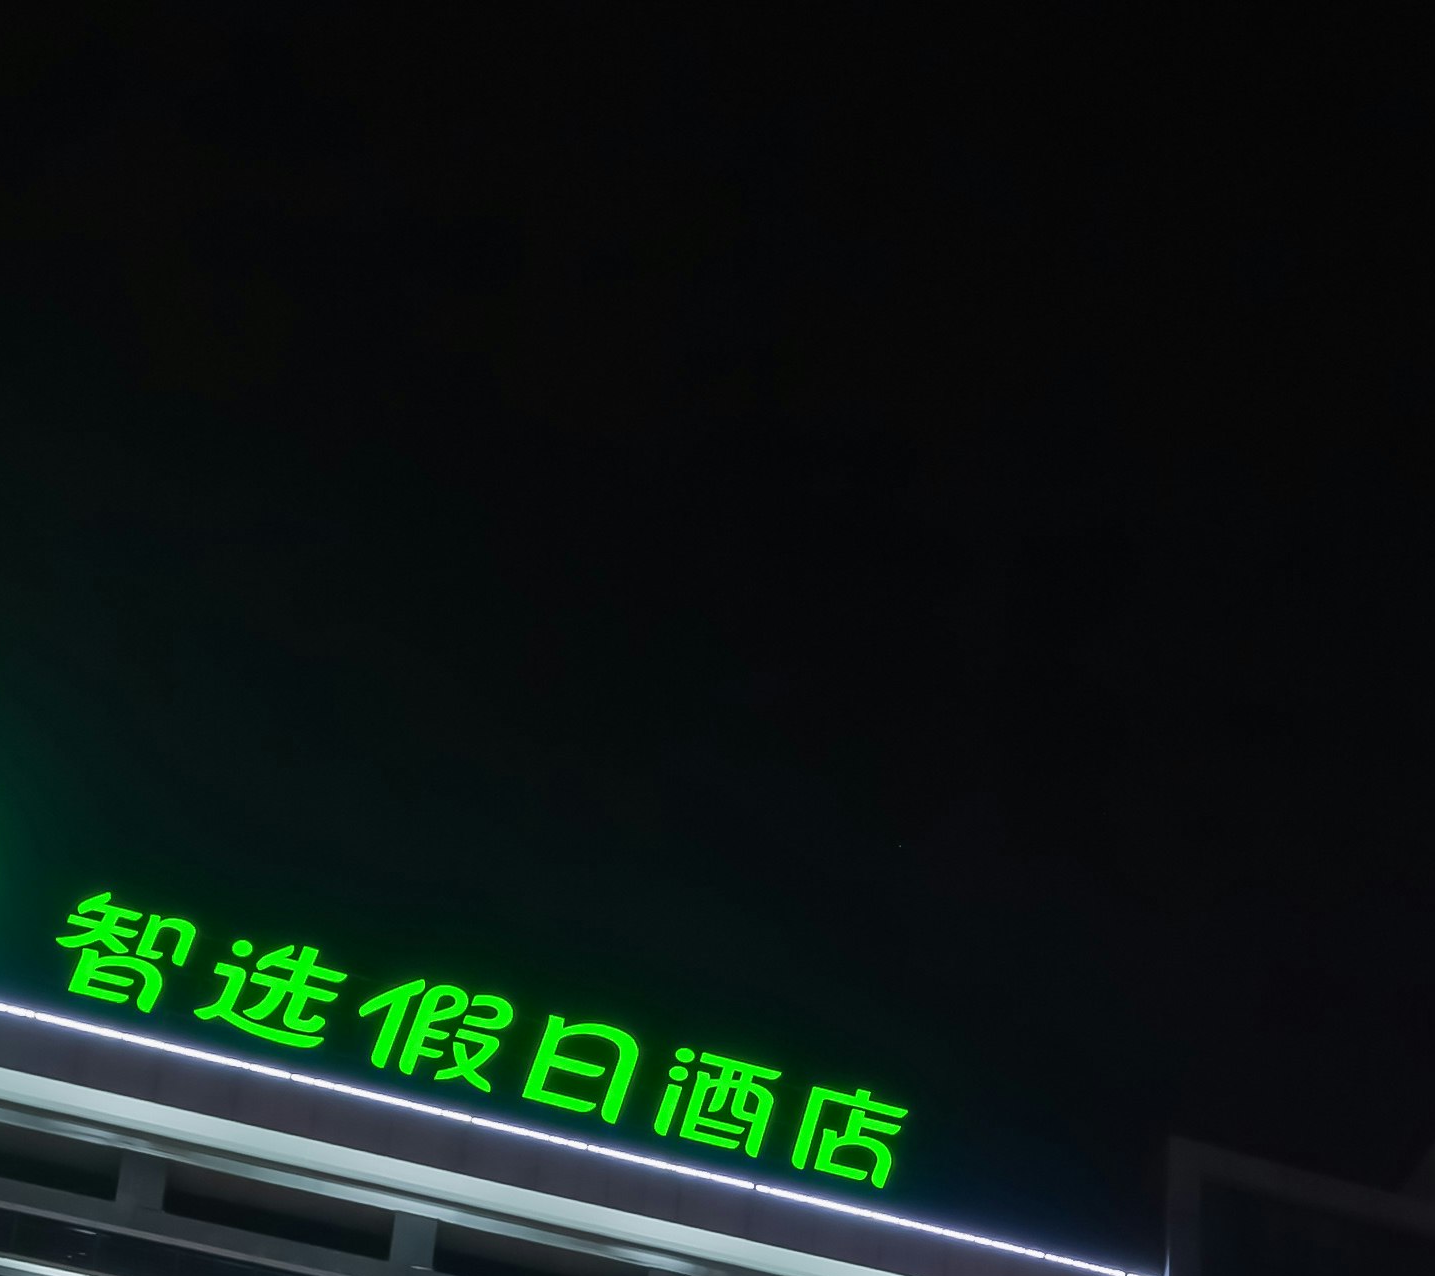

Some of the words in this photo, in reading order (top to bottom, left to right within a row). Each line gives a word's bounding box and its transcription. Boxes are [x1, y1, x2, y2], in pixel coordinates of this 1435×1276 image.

[55, 891, 910, 1189] 智选假日酒店
